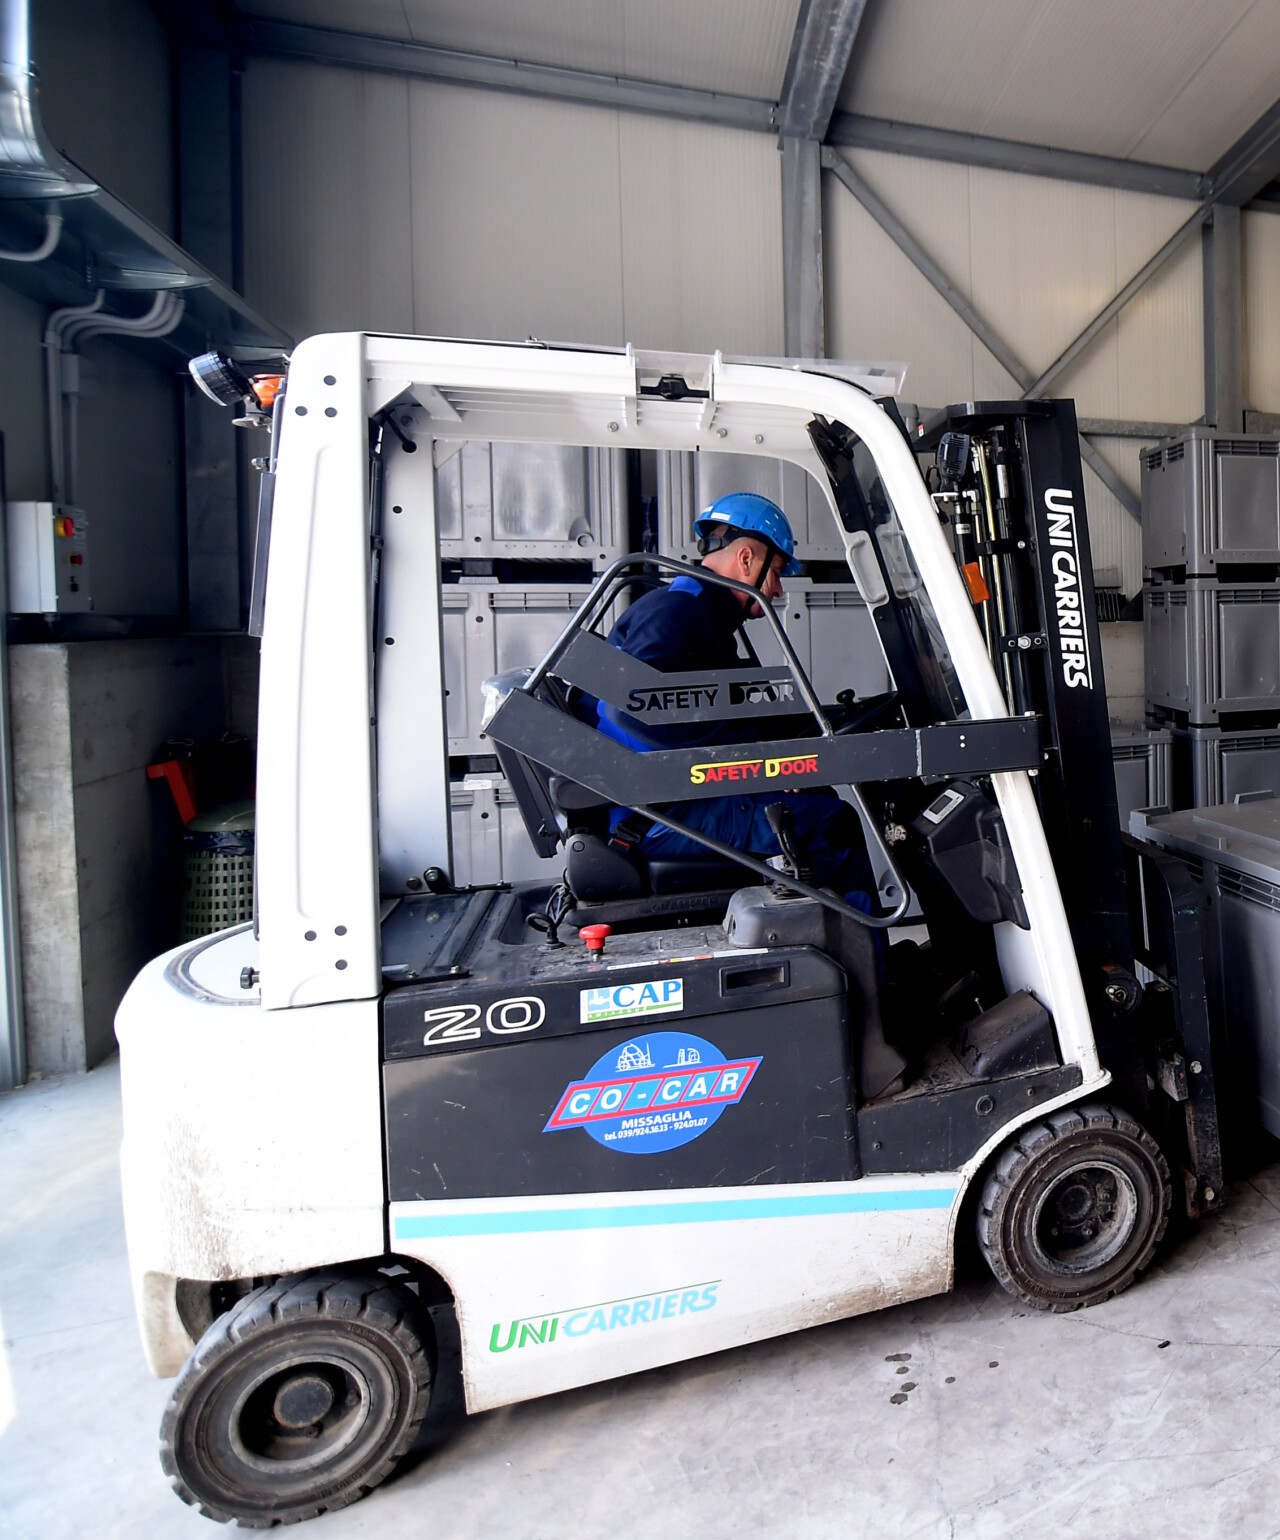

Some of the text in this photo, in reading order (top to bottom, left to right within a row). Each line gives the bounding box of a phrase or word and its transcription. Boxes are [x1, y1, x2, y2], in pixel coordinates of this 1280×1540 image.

[626, 678, 794, 712] SAFETY DOOR
[690, 754, 818, 785] SAFETY DOOR
[612, 980, 682, 1008] CAP
[423, 996, 546, 1046] 20
[569, 1072, 739, 1114] CO-CAR
[621, 1110, 692, 1130] MISSAGLIA
